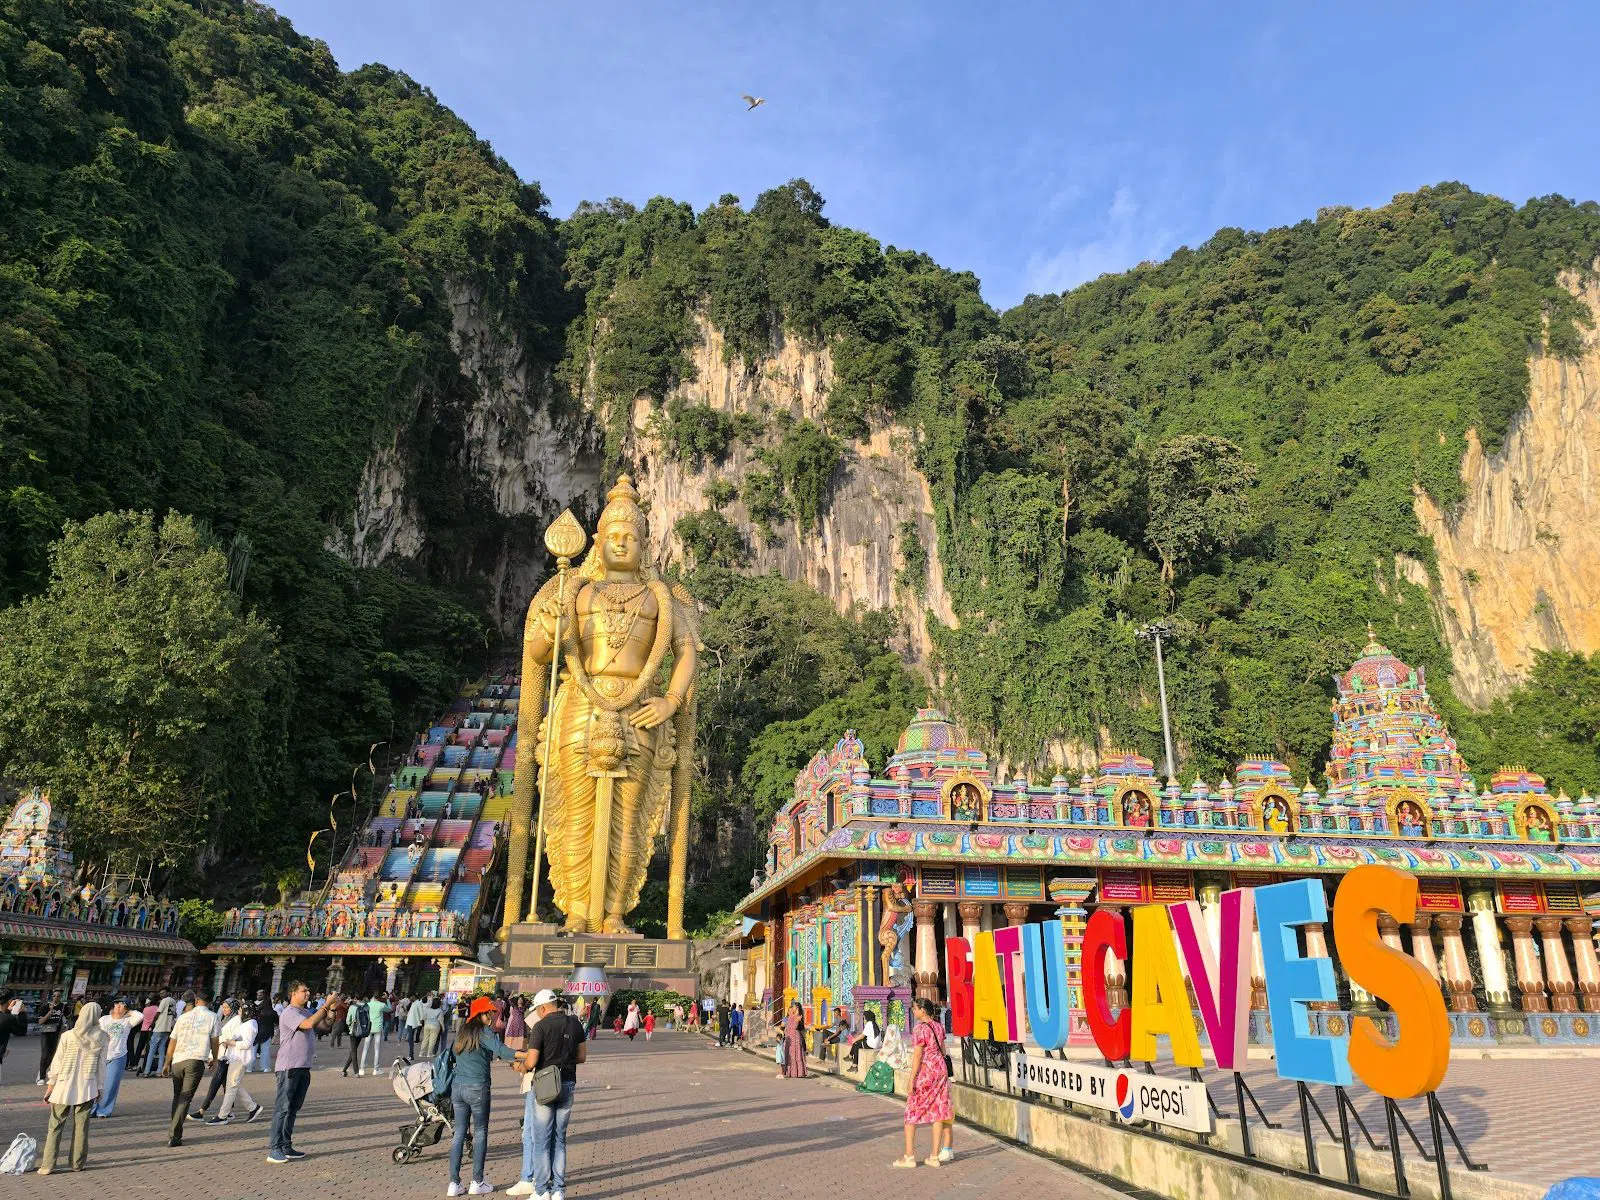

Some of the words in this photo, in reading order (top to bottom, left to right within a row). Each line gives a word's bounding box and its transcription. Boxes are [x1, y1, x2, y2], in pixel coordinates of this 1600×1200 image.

[945, 920, 1070, 1050] BATU
[1081, 864, 1450, 1100] CAVES
[1016, 1062, 1082, 1092] SPONSORED
[1090, 1076, 1105, 1098] BY
[1140, 1085, 1185, 1119] pepsi
